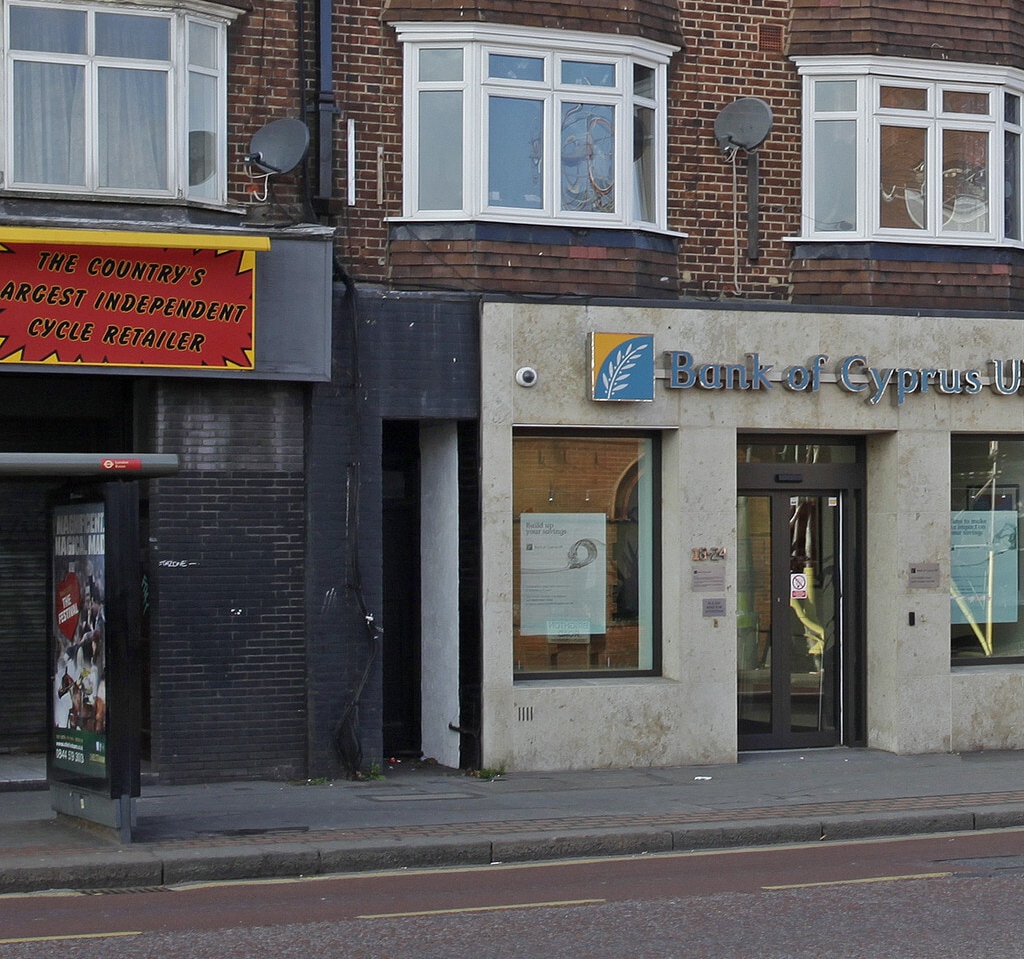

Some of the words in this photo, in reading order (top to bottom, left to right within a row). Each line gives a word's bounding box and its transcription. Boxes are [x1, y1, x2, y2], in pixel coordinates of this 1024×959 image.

[37, 252, 80, 274] THE
[88, 257, 207, 287] COUNTRY'S
[93, 291, 248, 324] INDEPENDENT
[27, 317, 95, 342] CYCLE
[102, 324, 206, 353] RETAILER
[665, 350, 773, 391] Bank
[785, 354, 829, 392] of
[840, 354, 981, 406] Cyprus
[542, 528, 567, 536] savings
[545, 523, 554, 531] up
[58, 602, 79, 625] FESTIVAL
[62, 593, 72, 608] THE
